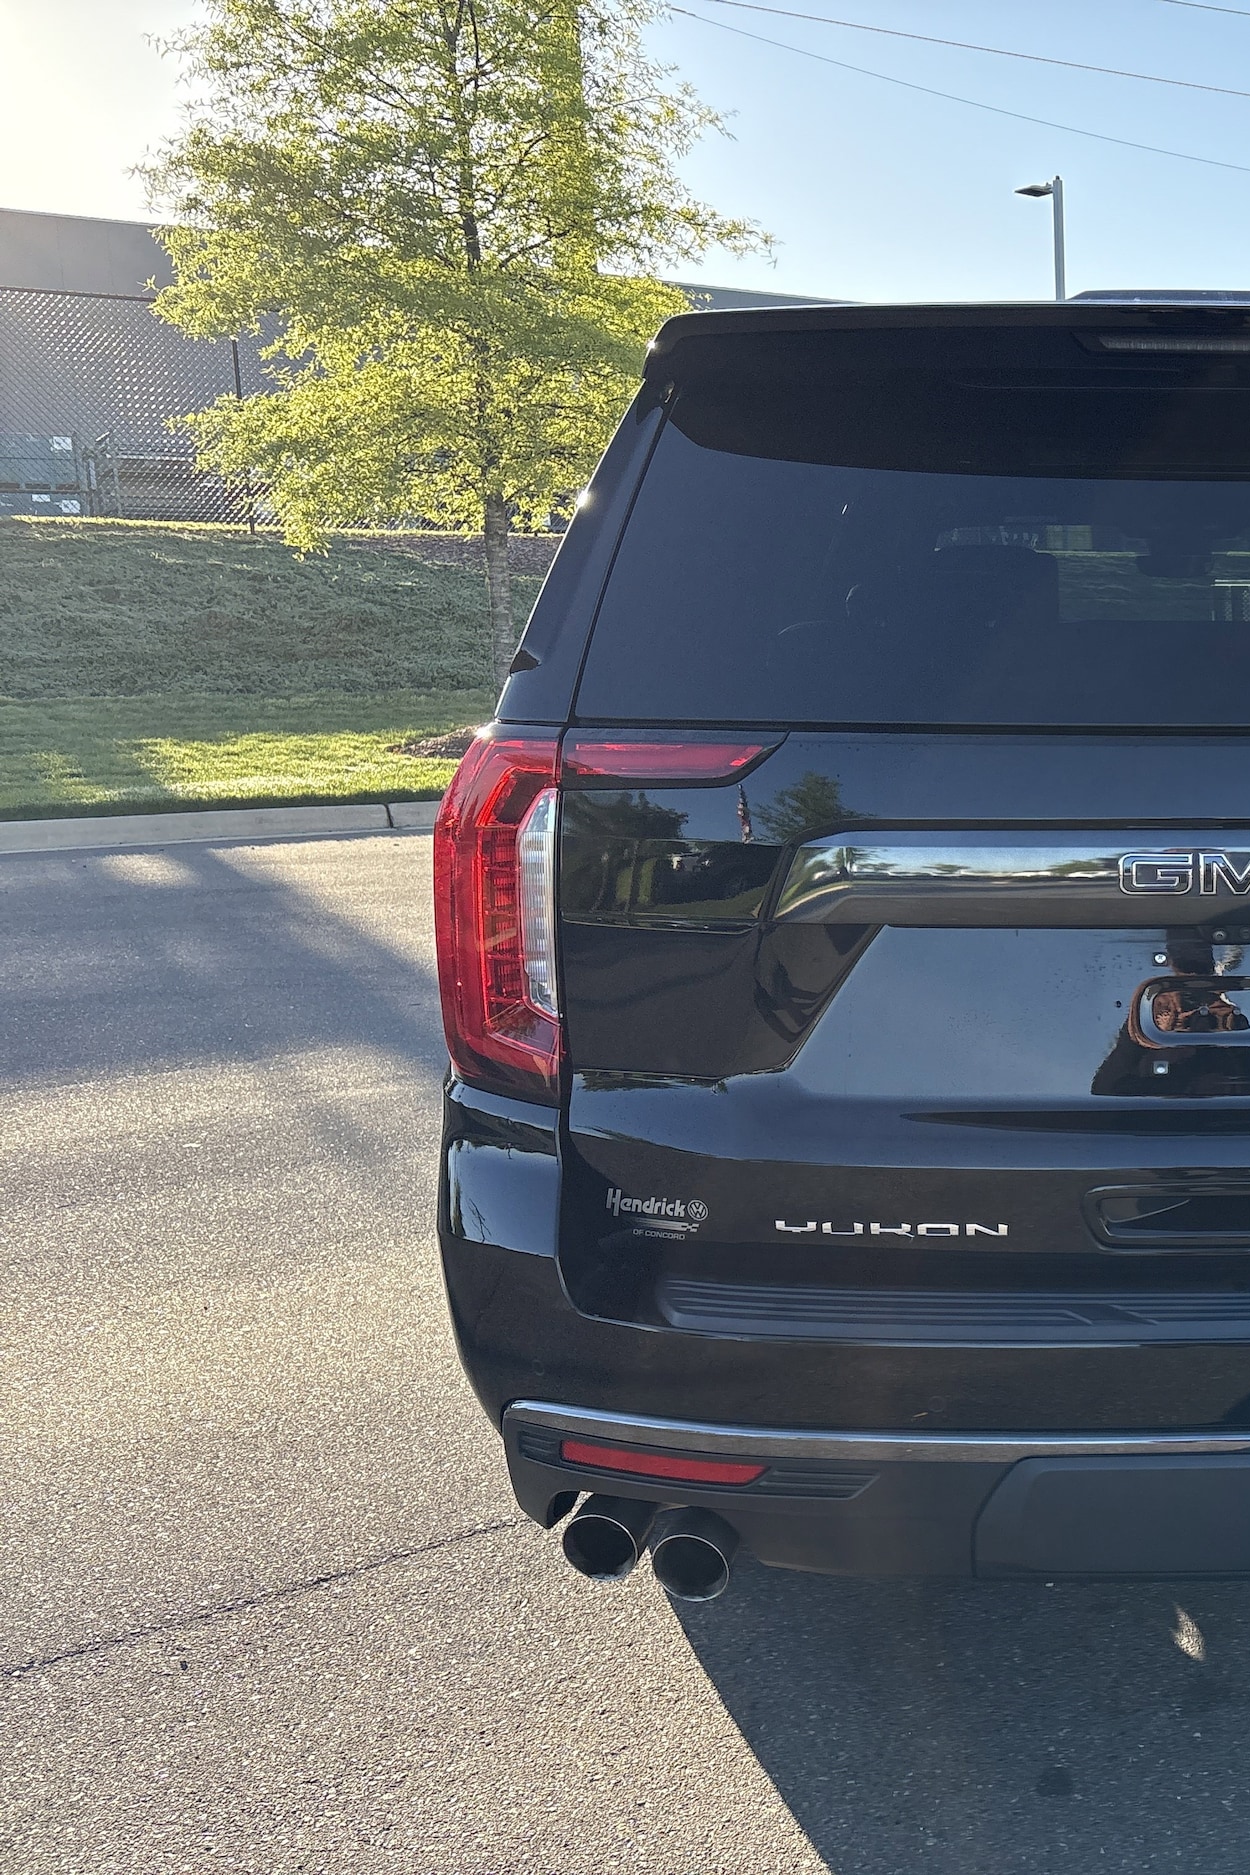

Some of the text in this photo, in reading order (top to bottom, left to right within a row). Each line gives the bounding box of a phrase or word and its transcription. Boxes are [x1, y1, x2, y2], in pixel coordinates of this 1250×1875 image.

[605, 1187, 688, 1217] Hendrick
[644, 1229, 686, 1241] CONCORD
[775, 1219, 1009, 1238] YUKON
